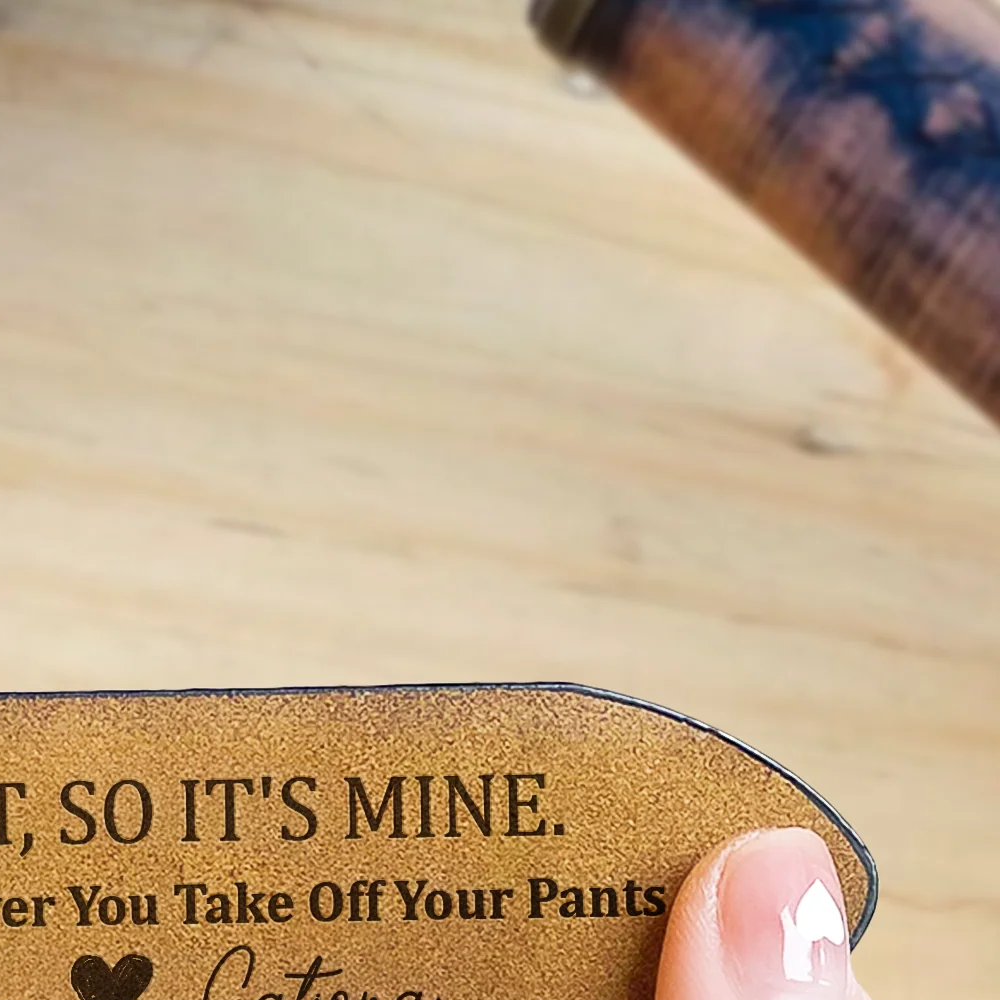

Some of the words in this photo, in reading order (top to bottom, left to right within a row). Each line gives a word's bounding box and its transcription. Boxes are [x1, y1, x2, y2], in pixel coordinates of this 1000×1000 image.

[59, 778, 153, 845] SO
[180, 774, 318, 843] IT'S
[343, 773, 566, 841] MINE.
[67, 886, 158, 926] You
[174, 882, 294, 924] Take
[309, 879, 386, 922] Off
[396, 880, 515, 920] Your
[527, 878, 666, 918] Pants
